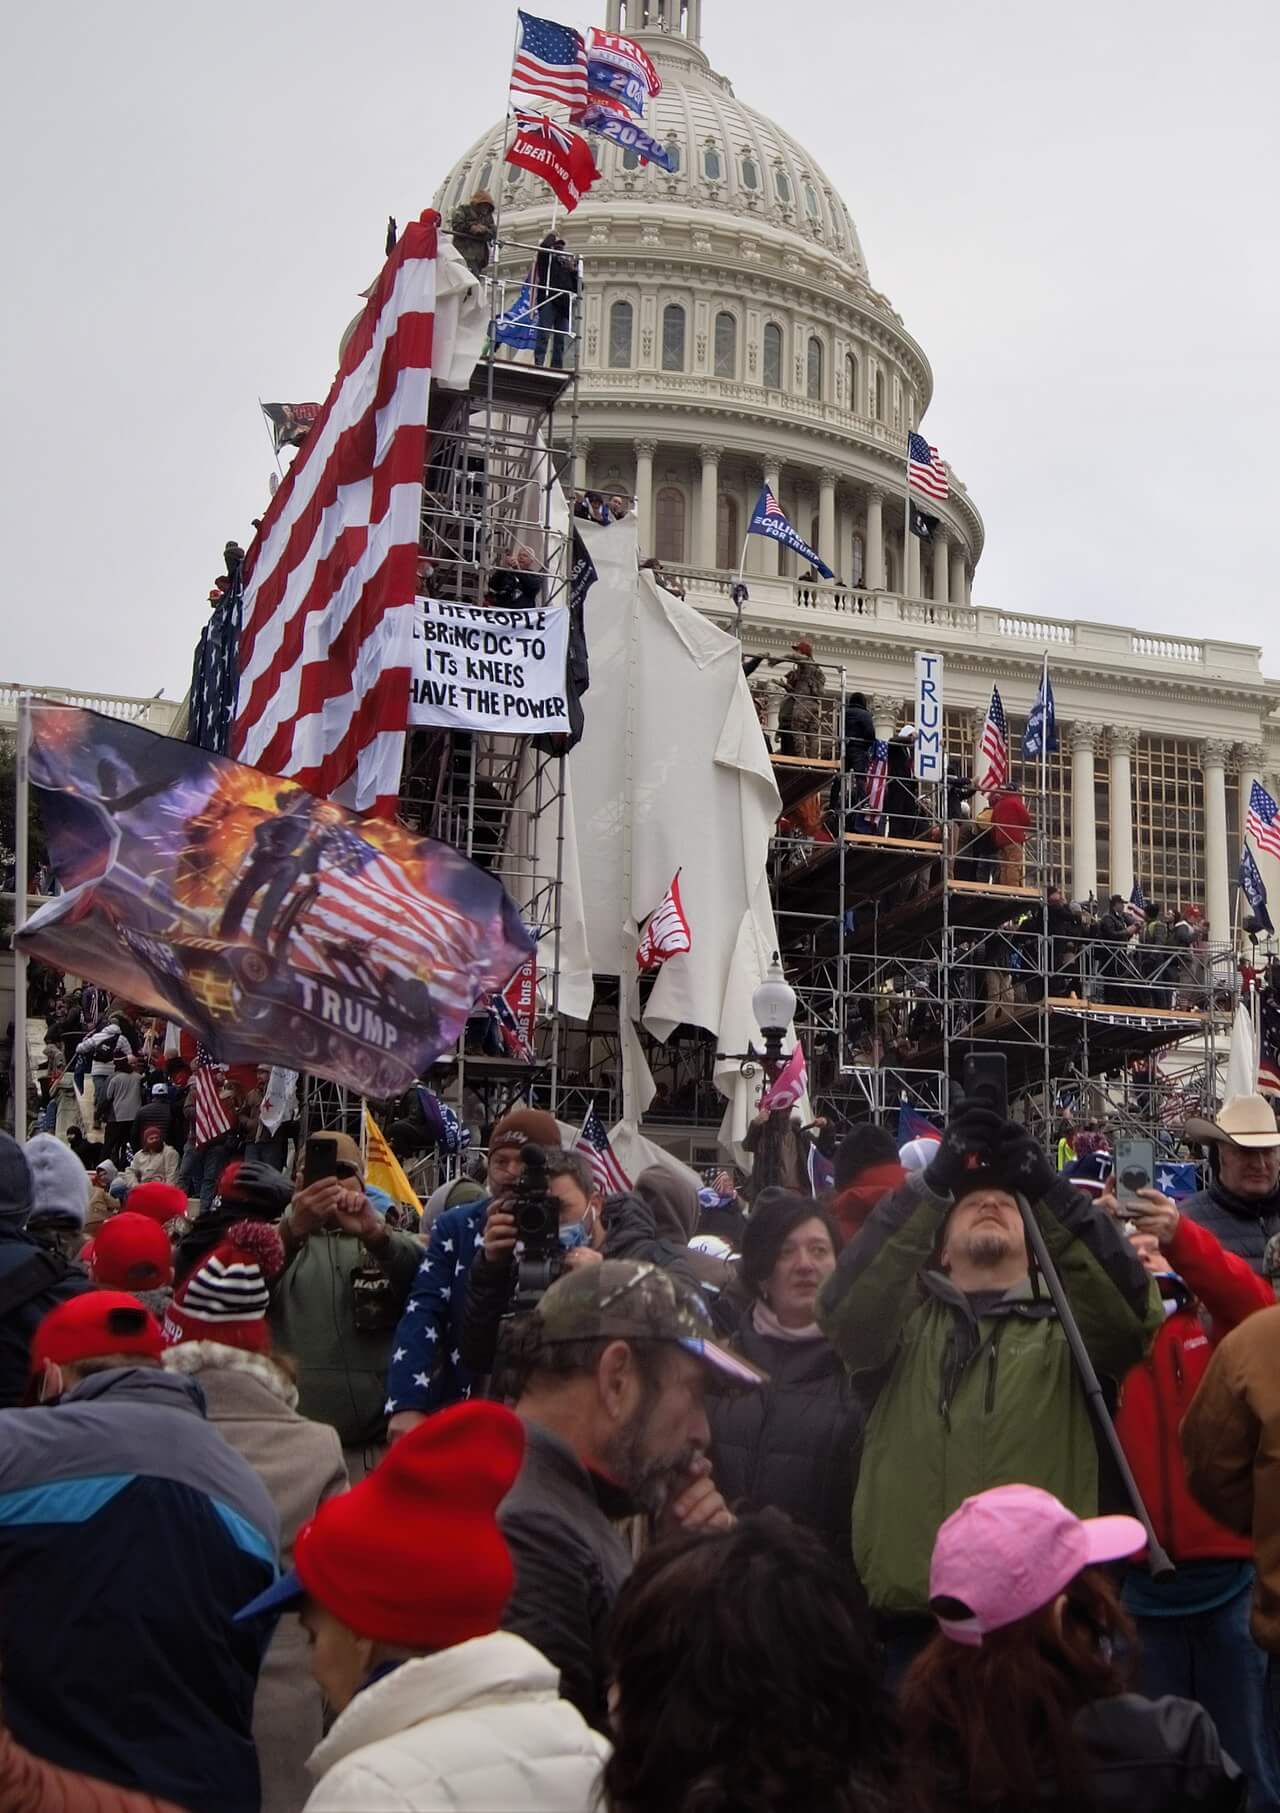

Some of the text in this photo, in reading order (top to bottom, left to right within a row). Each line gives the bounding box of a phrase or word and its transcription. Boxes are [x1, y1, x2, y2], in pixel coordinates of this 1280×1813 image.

[765, 526, 787, 540] FOR
[468, 607, 546, 631] PEOPLE
[483, 632, 513, 656] DC
[516, 637, 546, 660] TO
[408, 678, 567, 719] HAVE THE POWER
[917, 656, 939, 777] TRUMP
[294, 973, 399, 1050] TRUMP
[353, 1278, 390, 1290] NAVY
